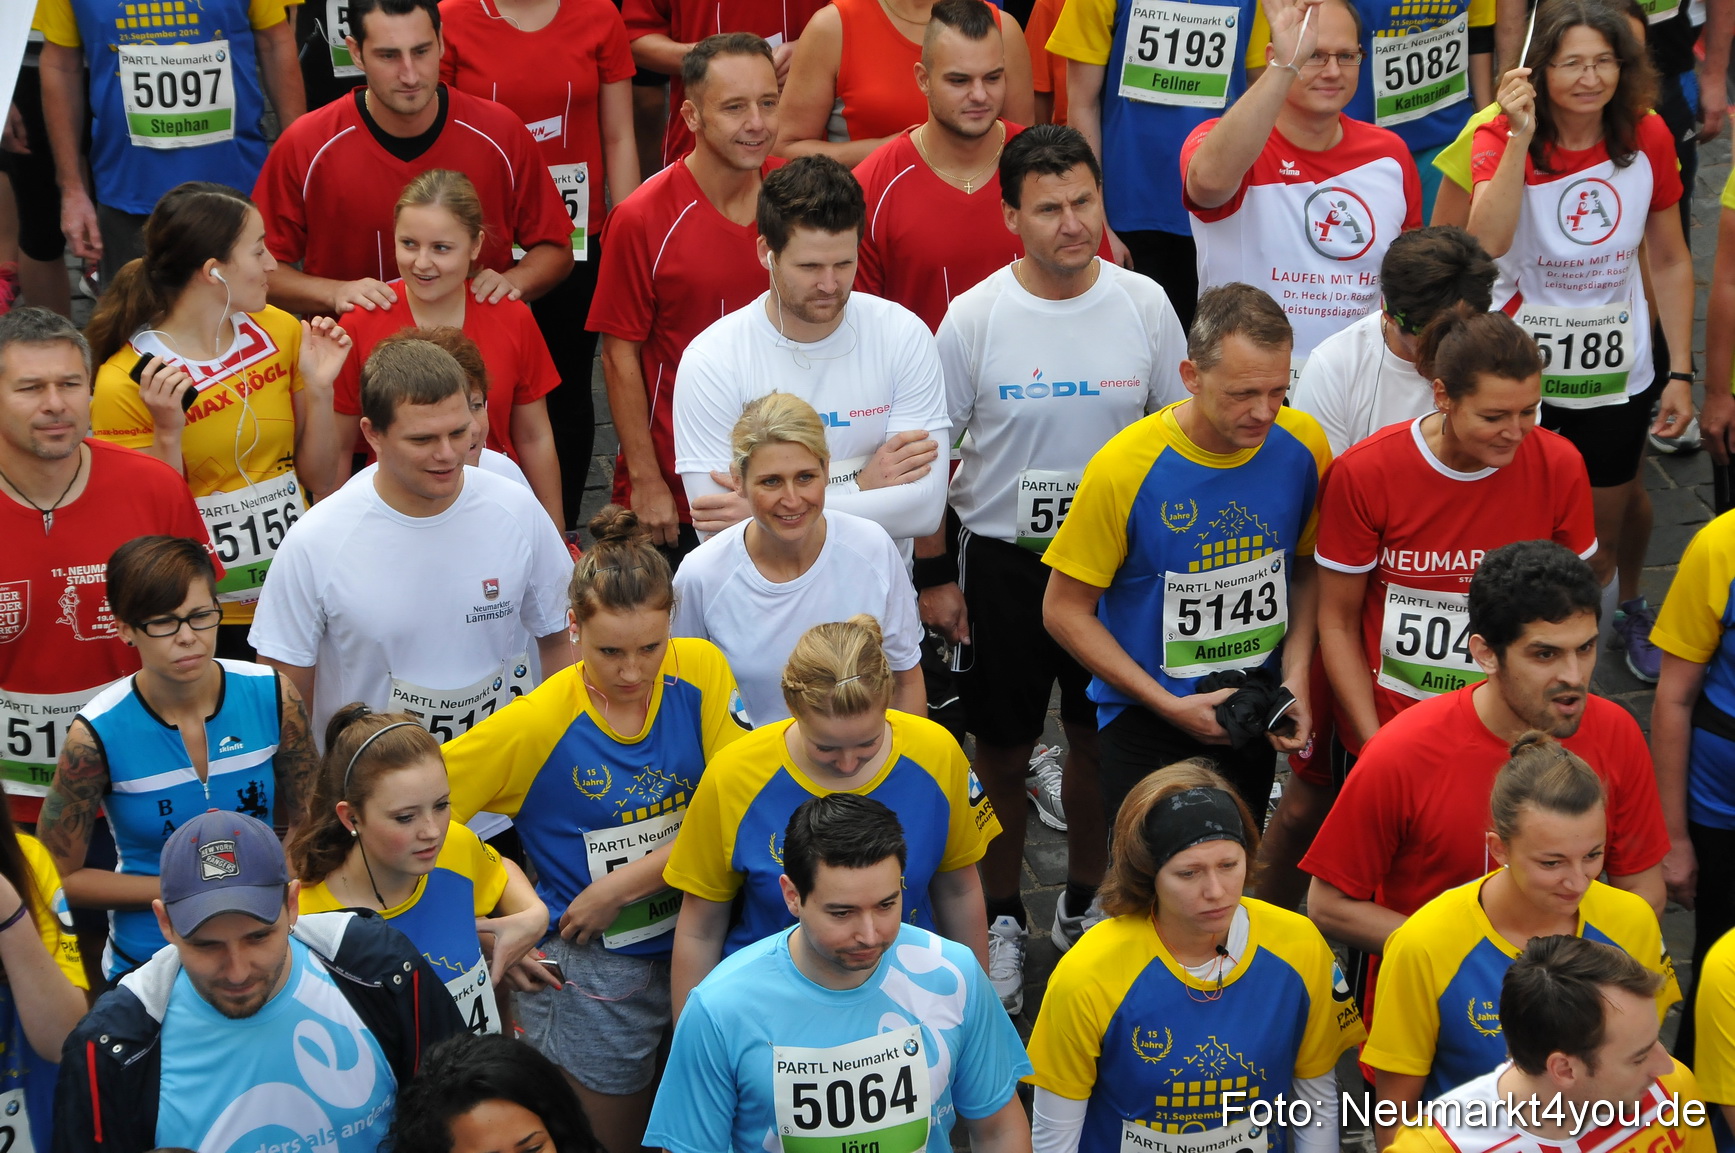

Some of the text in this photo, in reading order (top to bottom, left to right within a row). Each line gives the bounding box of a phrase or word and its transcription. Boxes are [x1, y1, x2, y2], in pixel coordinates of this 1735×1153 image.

[1133, 7, 1222, 26] PARTL Neumarkt
[119, 28, 200, 42] 21.September 2014
[1375, 29, 1455, 55] PARTL Neumarkt
[1138, 25, 1227, 68] 5193
[121, 54, 213, 65] PARTL Neumarkt
[1385, 39, 1462, 90] 5082
[133, 68, 221, 108] 5097
[1152, 73, 1202, 92] Fellner
[1395, 83, 1450, 111] Katharina
[151, 118, 209, 136] Stephan
[1562, 271, 1584, 279] Heck
[1592, 269, 1605, 277] Dr.
[1283, 290, 1299, 299] Dr.
[1301, 291, 1328, 301] Heck
[1335, 292, 1350, 301] Dr.
[1523, 315, 1616, 328] PARTL Neumarkt
[1533, 329, 1625, 370] 5188
[1100, 376, 1141, 388] energie
[1545, 379, 1602, 394] Claudia
[184, 361, 288, 426] MAX BÖGL
[1022, 481, 1064, 492] PARTL
[198, 487, 288, 518] PARTL Neumarkt
[1174, 503, 1184, 511] 15
[1169, 512, 1191, 521] Jahre
[212, 502, 299, 563] 5156
[51, 568, 67, 578] 11.
[1167, 568, 1268, 593] PARTL Neumarkt
[473, 600, 511, 613] Neumarkter
[1178, 581, 1278, 636] 5143
[1390, 593, 1434, 609] PARTL
[1396, 612, 1473, 664] 504
[1195, 637, 1261, 660] Andreas
[1421, 670, 1467, 692] Anita
[393, 688, 437, 709] PARTL
[440, 686, 491, 709] Neumarkt
[404, 697, 497, 744] 517
[7, 717, 71, 758] 51
[219, 743, 244, 753] skinfit
[586, 769, 597, 777] 15
[582, 778, 605, 787] Jahre
[215, 843, 233, 851] YORK
[590, 838, 636, 854] PARTL
[205, 855, 236, 873] RANGERS
[1482, 1001, 1493, 1010] 15
[1147, 1030, 1158, 1039] 15
[1140, 1040, 1164, 1049] Jahre
[777, 1047, 900, 1075] PARTL Neumarkt
[792, 1064, 918, 1131] 5064
[306, 1127, 336, 1148] als
[1125, 1130, 1243, 1153] PARTL Neumarkt
